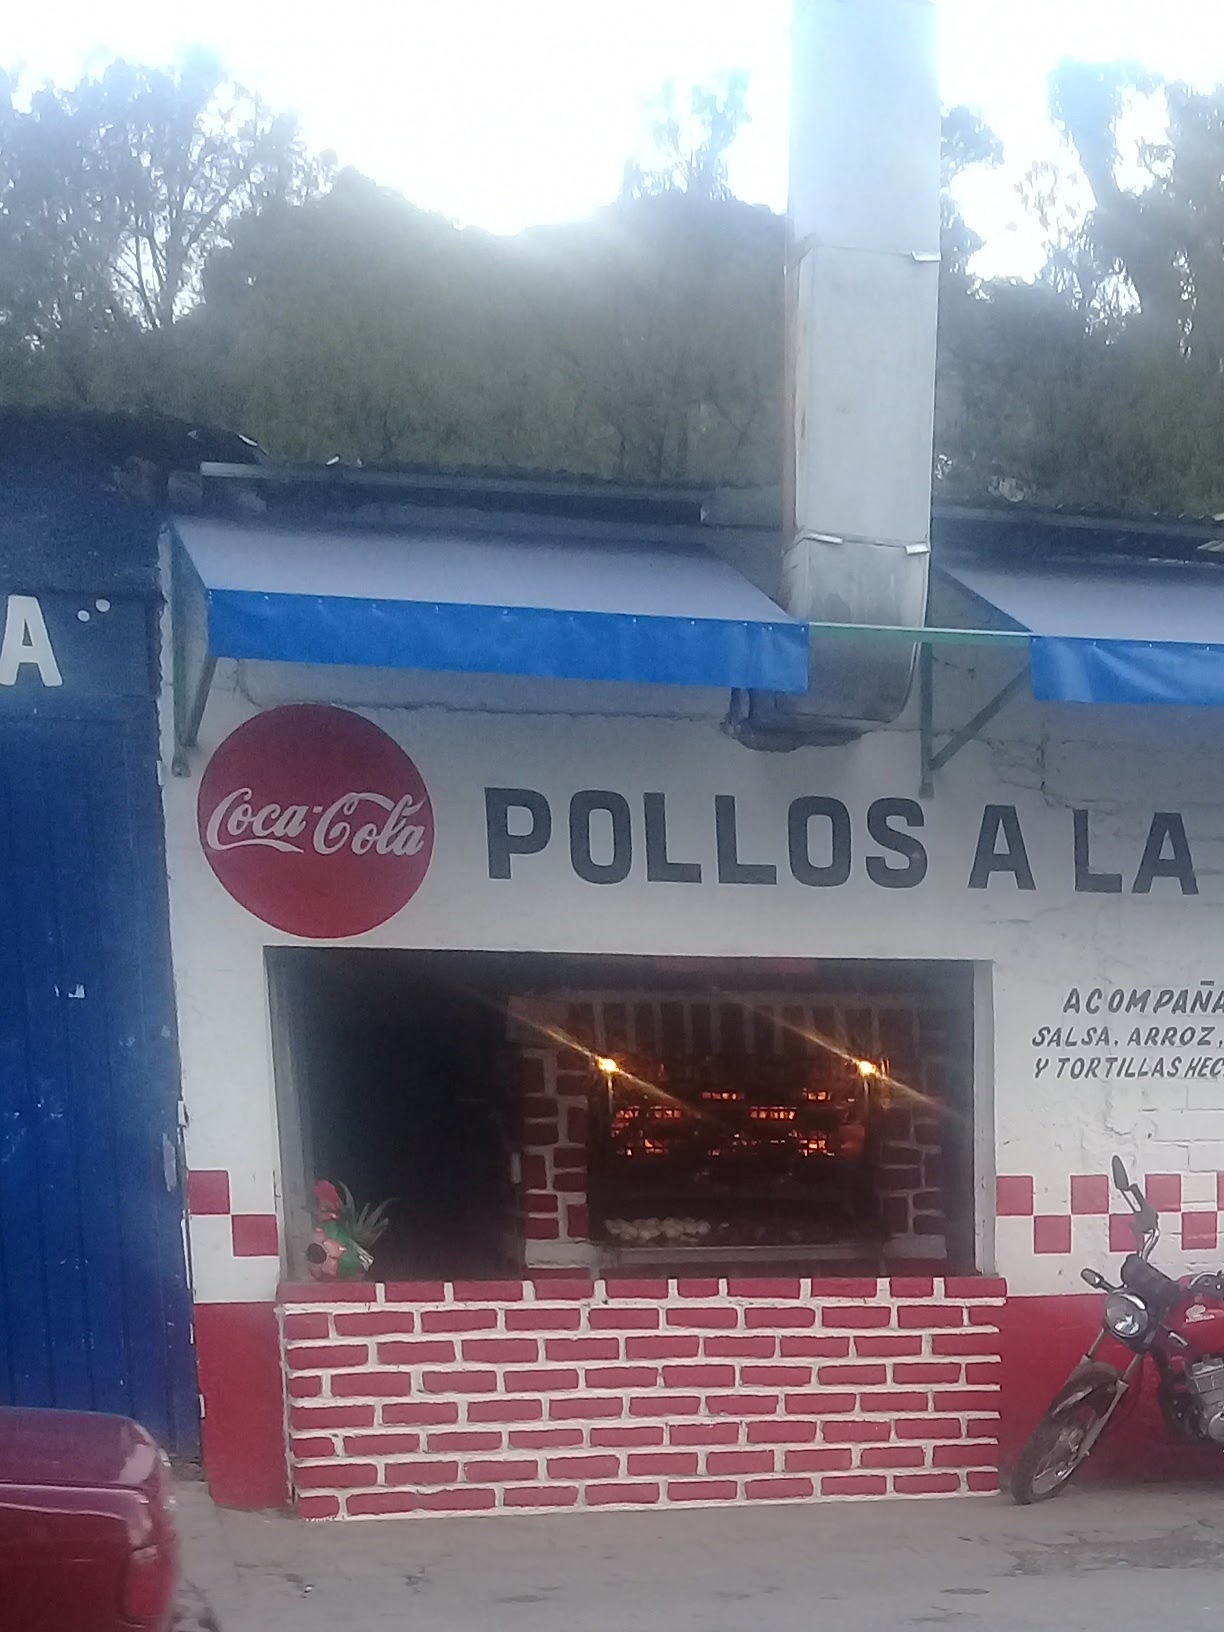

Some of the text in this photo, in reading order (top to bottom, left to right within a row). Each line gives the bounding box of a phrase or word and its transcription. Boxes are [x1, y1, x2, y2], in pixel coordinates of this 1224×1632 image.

[0, 594, 64, 687] A
[205, 786, 426, 857] Coca-Cola
[484, 786, 929, 889] POLLOS
[967, 804, 1037, 890] A
[1073, 808, 1200, 895] LA
[1034, 1057, 1050, 1079] Y
[1056, 1057, 1182, 1080] TORTILLAS
